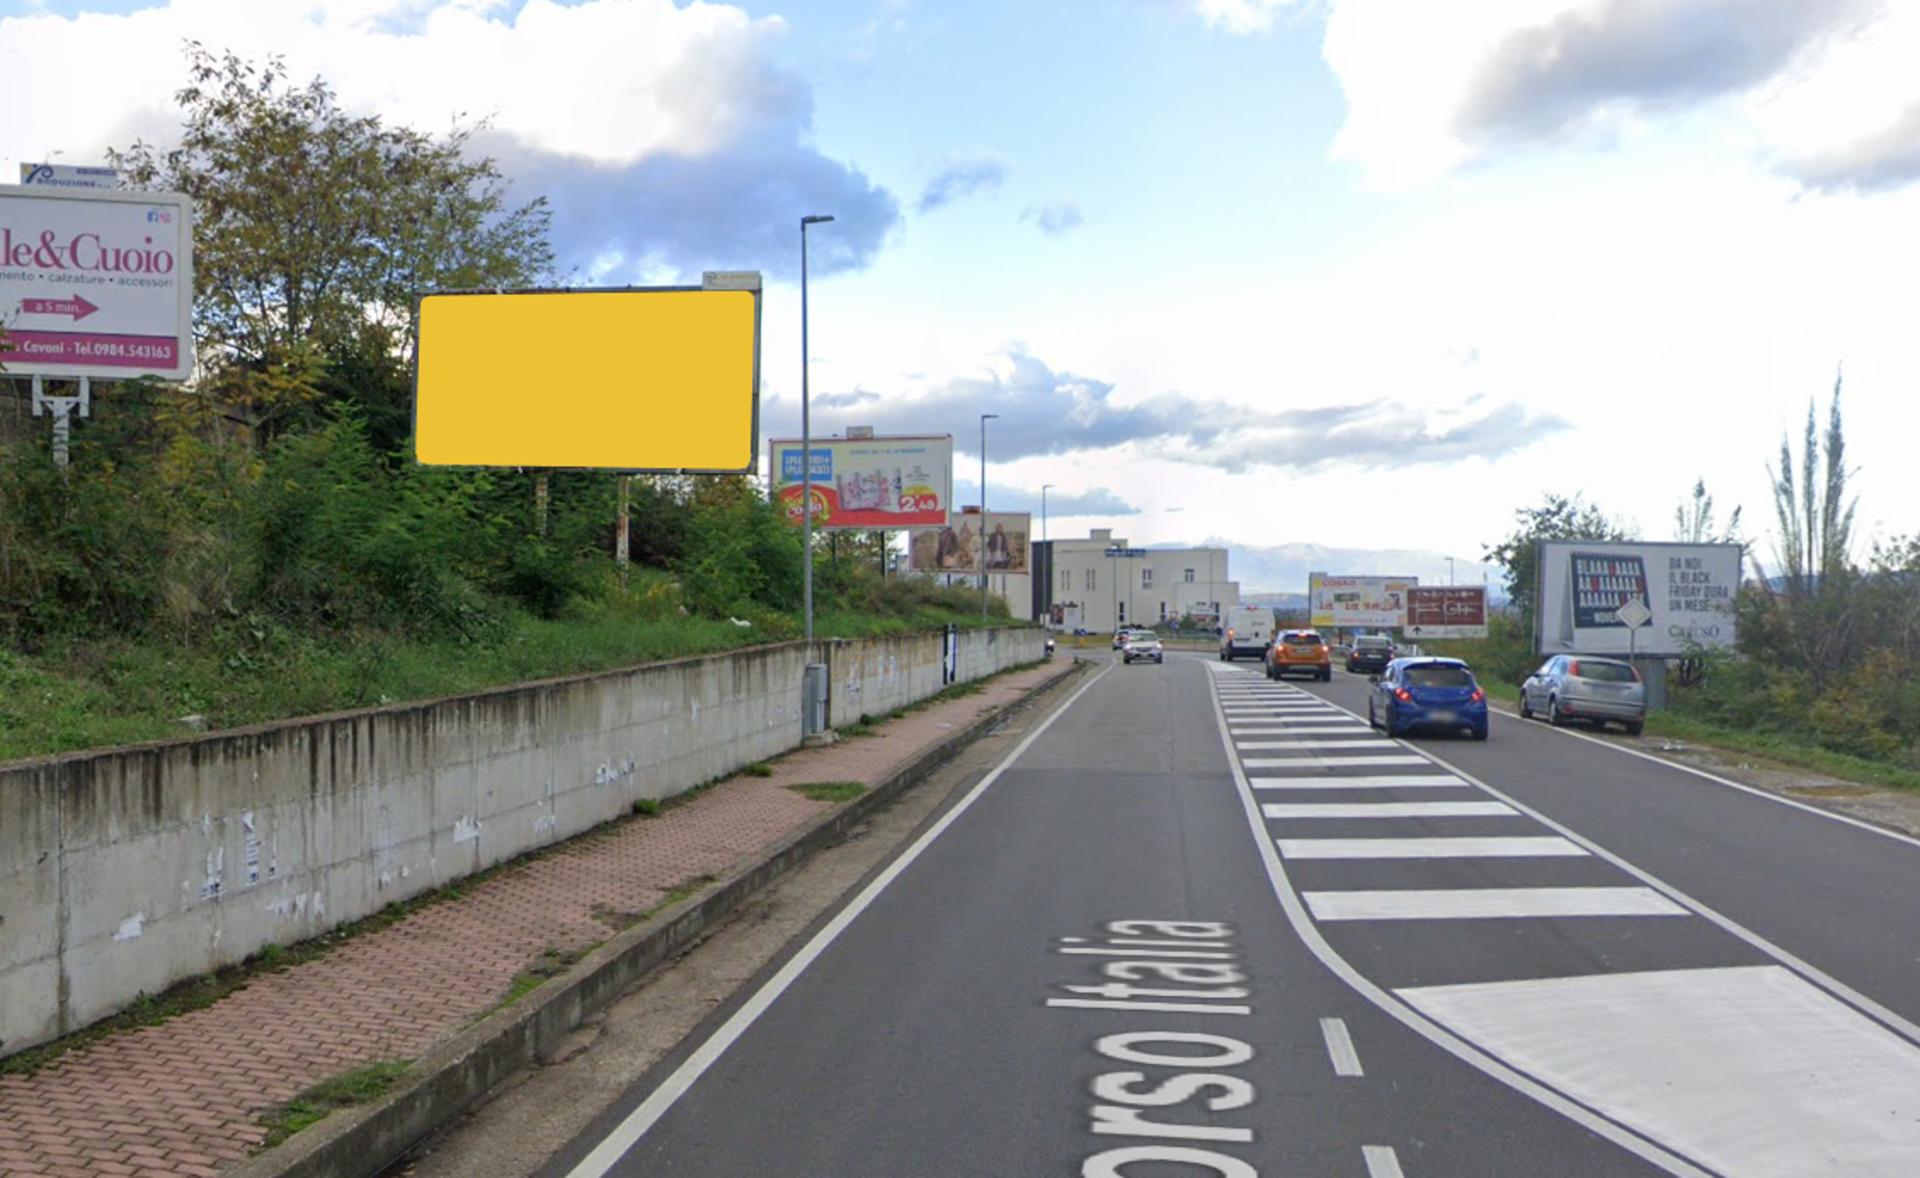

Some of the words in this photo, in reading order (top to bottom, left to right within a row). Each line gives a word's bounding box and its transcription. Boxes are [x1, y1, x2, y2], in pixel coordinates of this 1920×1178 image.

[49, 273, 105, 285] calzature
[117, 276, 173, 288] accessori
[36, 303, 43, 312] a
[1679, 572, 1711, 584] BLACK
